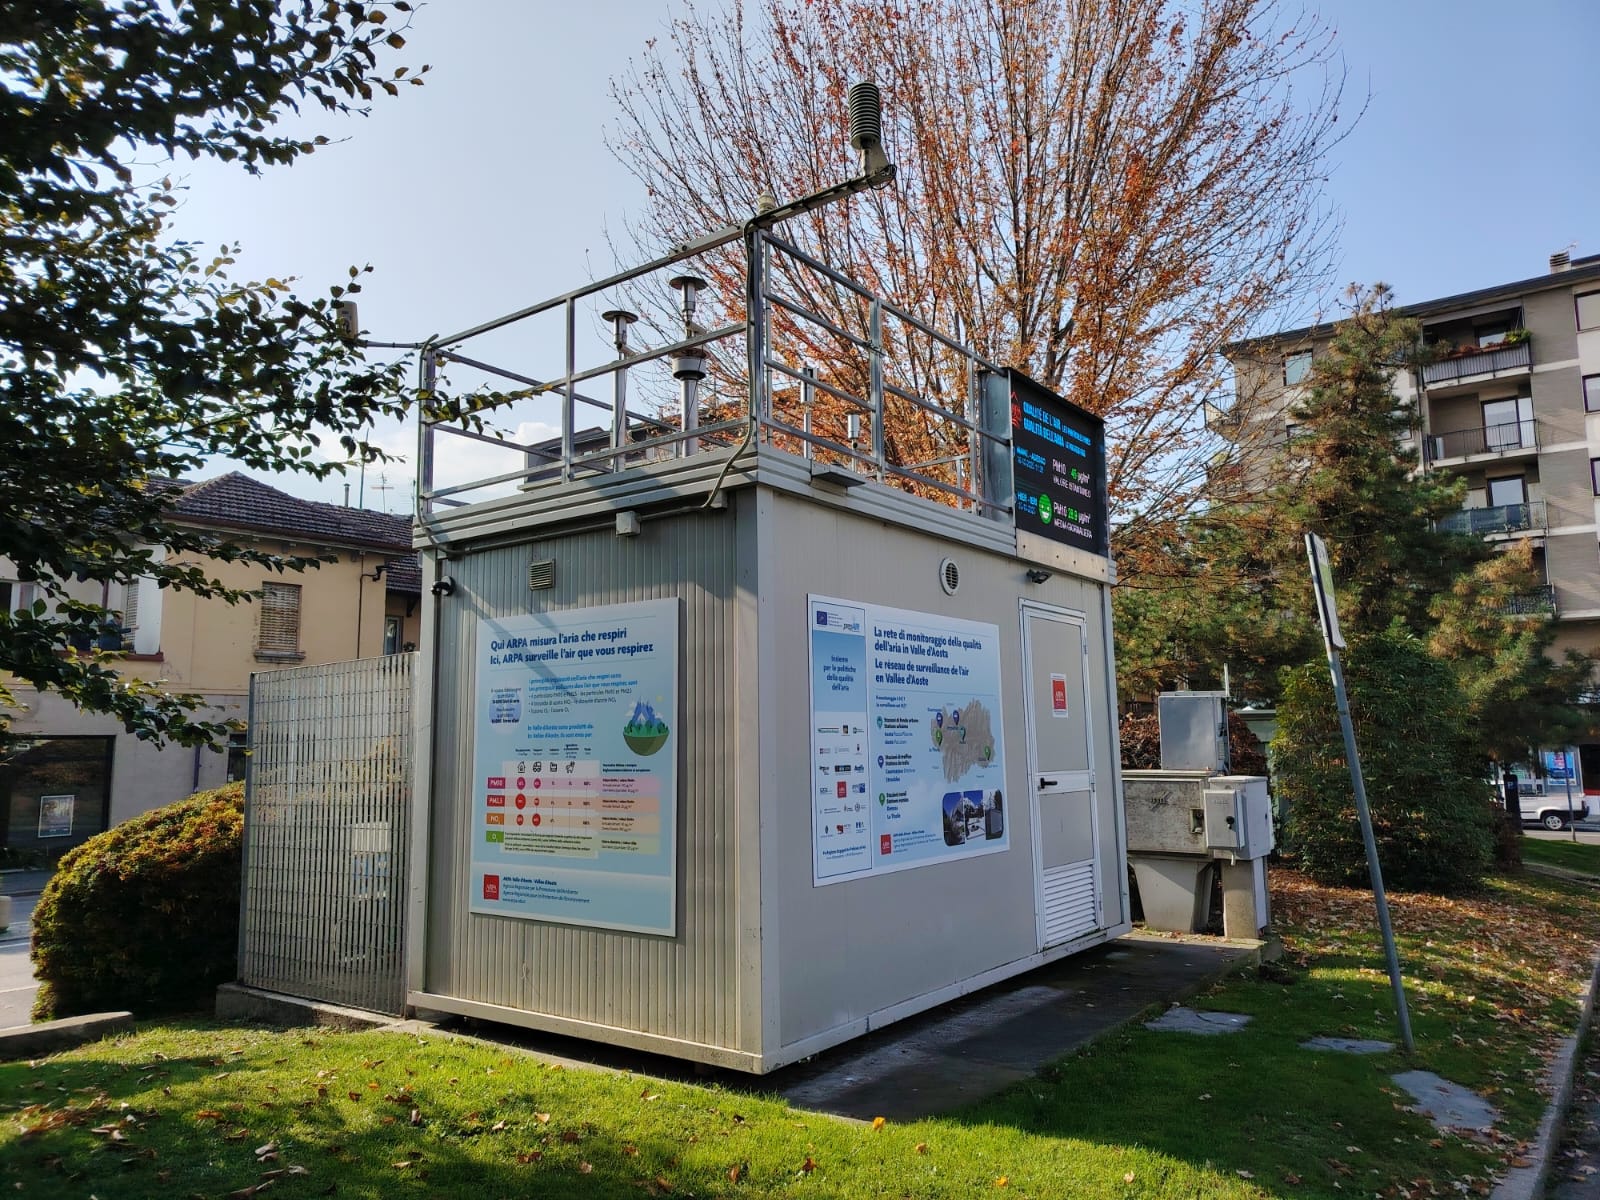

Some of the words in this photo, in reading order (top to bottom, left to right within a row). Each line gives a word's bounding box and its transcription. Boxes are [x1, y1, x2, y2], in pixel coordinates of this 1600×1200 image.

[1052, 458, 1067, 475] PM10
[491, 640, 505, 652] Qui
[507, 638, 528, 649] ARPA
[530, 635, 557, 647] misura
[559, 632, 579, 644] l'aria
[581, 630, 596, 641] che
[598, 628, 627, 642] respiri
[874, 626, 882, 637] La
[884, 629, 898, 639] rete
[899, 629, 906, 640] di
[906, 633, 947, 648] monitoraggio
[948, 636, 961, 647] della
[962, 639, 982, 651] qualità
[490, 655, 501, 665] Ici,
[503, 653, 523, 664] ARPA
[525, 649, 559, 662] surveille
[560, 648, 576, 659] l'air
[578, 648, 593, 660] que
[595, 646, 615, 656] vous
[617, 642, 653, 657] respirez
[875, 639, 901, 652] dell'aria
[903, 643, 909, 654] in
[910, 645, 926, 656] Valle
[927, 646, 949, 658] d'Aosta
[875, 657, 883, 669] Le
[884, 660, 905, 671] réseau
[907, 660, 915, 672] de
[916, 663, 950, 675] surveillance
[951, 664, 958, 675] de
[959, 665, 969, 676] l'air
[875, 674, 884, 683] en
[906, 673, 929, 686] d'Aoste
